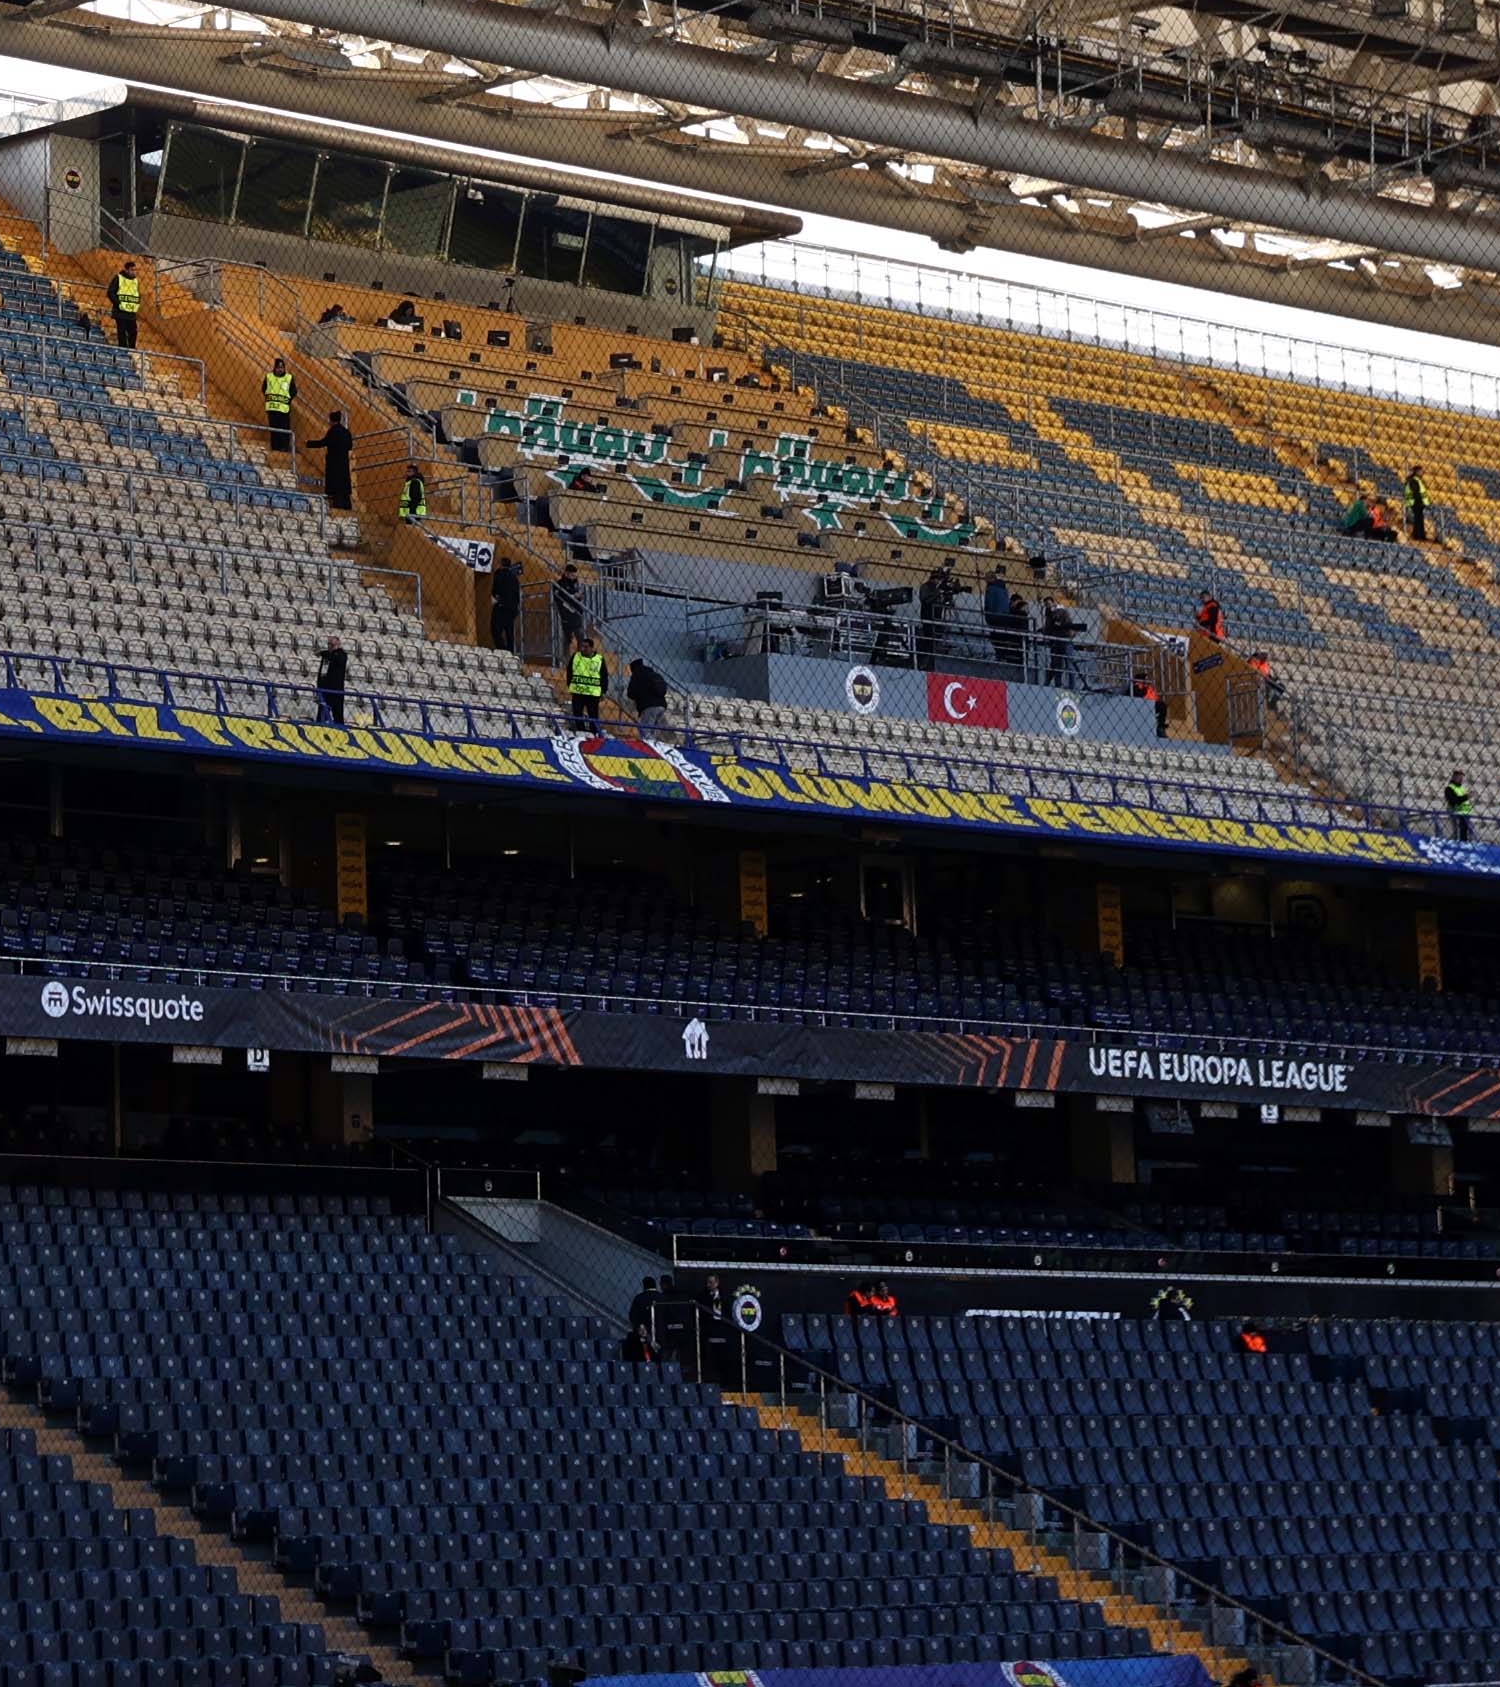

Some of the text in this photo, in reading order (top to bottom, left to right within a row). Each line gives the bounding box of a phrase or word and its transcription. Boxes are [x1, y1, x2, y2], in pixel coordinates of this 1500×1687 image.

[71, 985, 205, 1026] Swissquote
[1088, 1046, 1350, 1093] UEFA EUROPA LEAGUE
